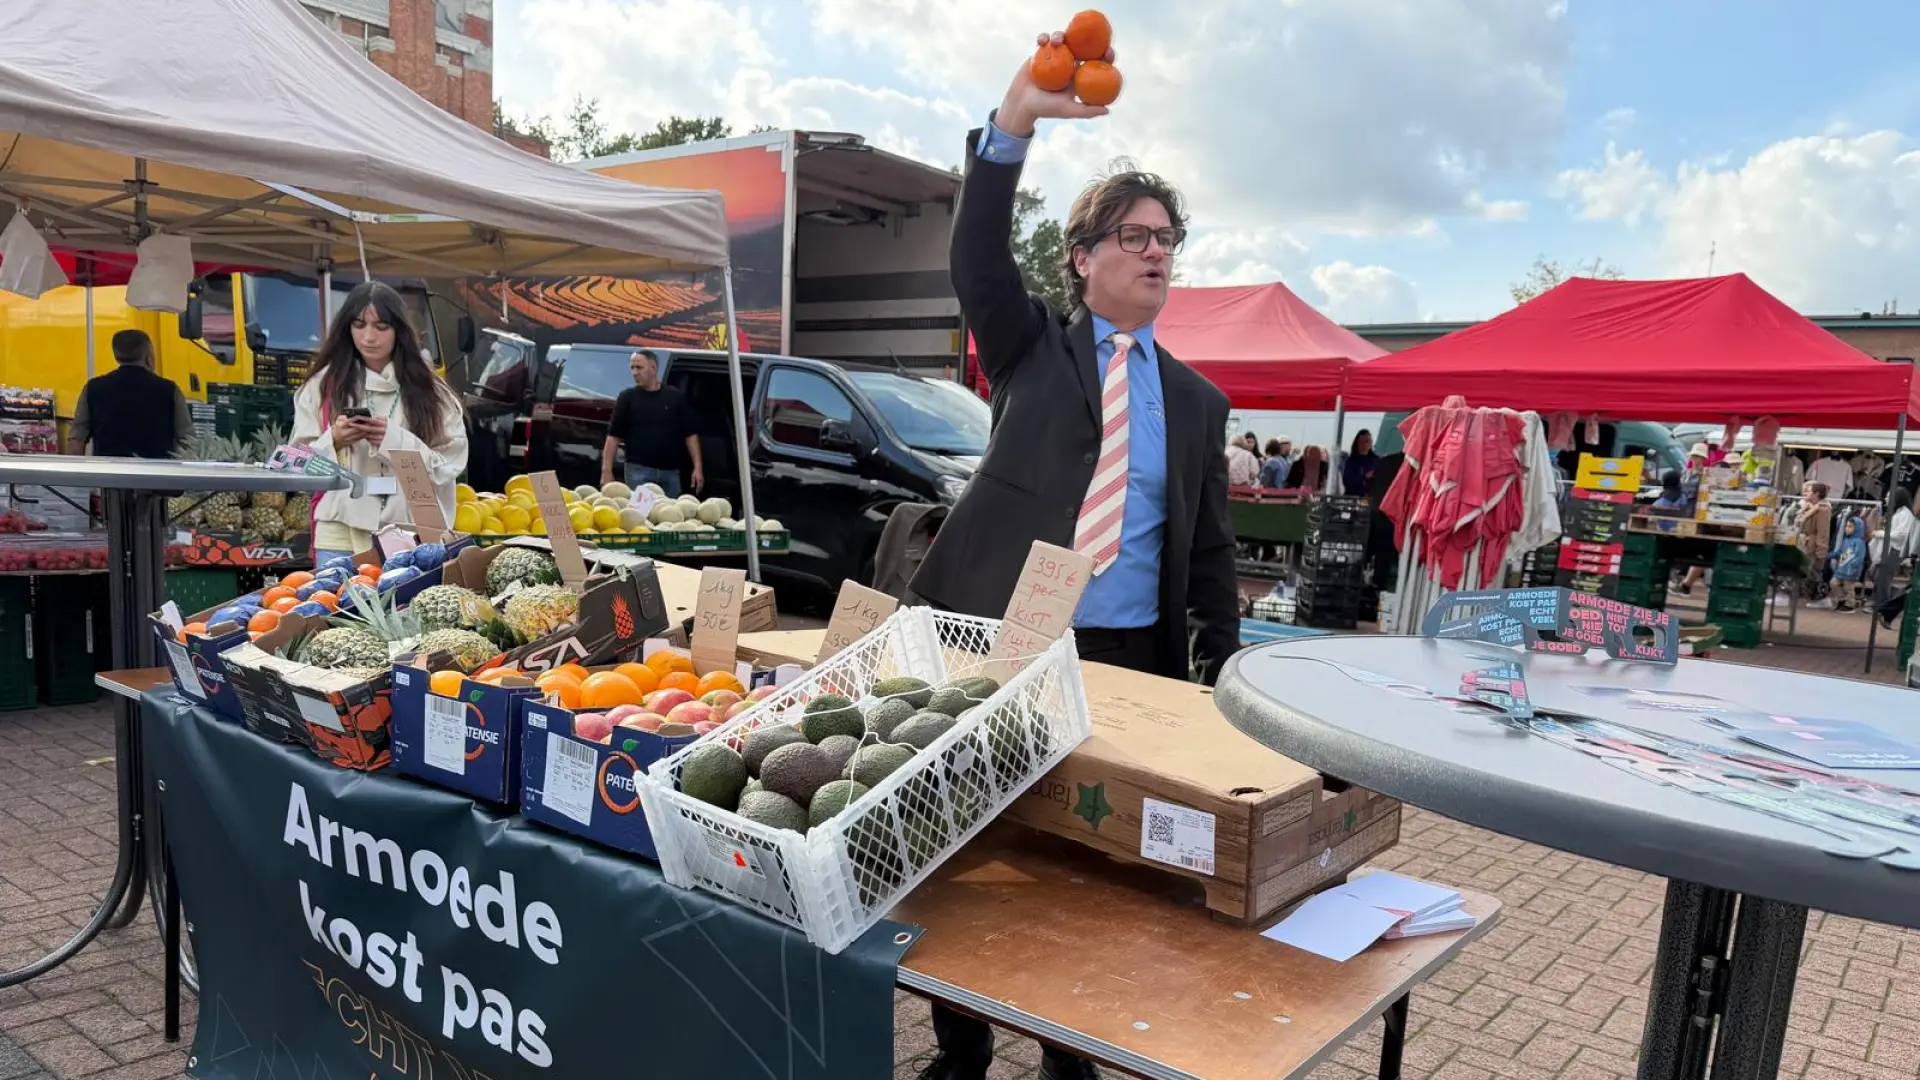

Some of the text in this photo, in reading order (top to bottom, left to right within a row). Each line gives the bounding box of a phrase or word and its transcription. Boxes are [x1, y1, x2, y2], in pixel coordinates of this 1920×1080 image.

[241, 547, 294, 559] VISA
[1507, 590, 1557, 600] ARMOEDE
[1509, 599, 1556, 608] KOST PAS
[1568, 591, 1631, 615] ARMOEDE
[1633, 606, 1652, 620] ZIE
[1655, 612, 1669, 626] JE
[1529, 607, 1555, 615] ECHT
[1478, 614, 1508, 625] ARMO
[1530, 616, 1554, 624] VEEL
[1606, 612, 1629, 625] NIET
[1480, 622, 1502, 632] KOST
[1499, 624, 1523, 636] ECHT
[1608, 621, 1627, 634] TOT
[1500, 633, 1523, 644] VEEL
[1562, 627, 1604, 644] JE GOED
[1547, 641, 1582, 653] GOED
[465, 726, 500, 744] ATENSIE
[283, 781, 563, 965] Armoede
[299, 879, 554, 1068] kost pas
